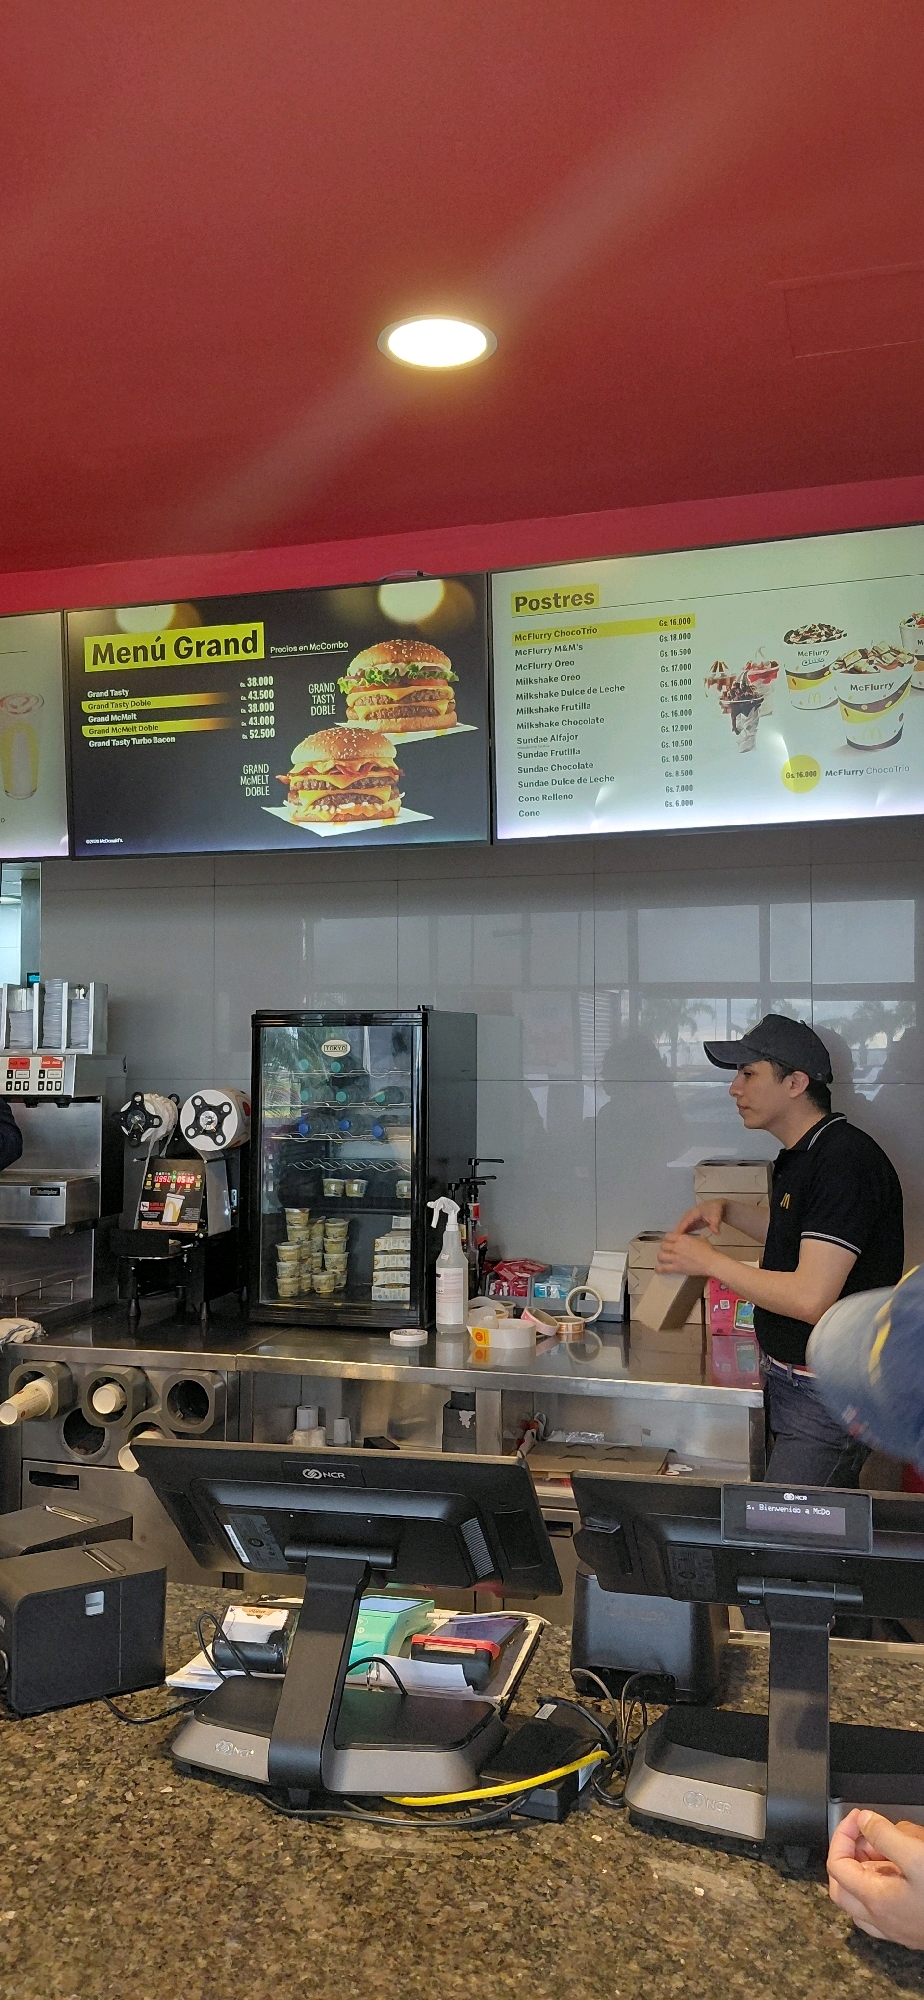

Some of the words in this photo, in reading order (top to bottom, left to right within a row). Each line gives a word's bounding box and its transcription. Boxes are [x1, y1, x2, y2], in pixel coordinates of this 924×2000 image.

[515, 592, 595, 612] Postres
[514, 632, 552, 642] McFlurry
[554, 626, 598, 638] ChocoTrio
[670, 617, 691, 626] 16.000
[92, 636, 166, 666] Menú
[174, 629, 258, 659] Grand
[270, 645, 297, 654] Precios
[309, 641, 348, 651] McCombo
[515, 647, 552, 657] McFlurry
[554, 643, 583, 652] M&M's
[670, 632, 691, 641] 18.000
[797, 649, 830, 657] McFlurry
[515, 661, 552, 671] McFlurry
[554, 659, 575, 668] Oreo
[660, 650, 668, 658] Gs.
[670, 648, 692, 657] 16.500
[515, 675, 559, 686] Milkshake
[560, 674, 581, 682] Oreo
[660, 665, 670, 673] Gs.
[671, 663, 692, 672] 17.000
[88, 690, 108, 698] Grand
[110, 688, 130, 698] Tasty
[247, 676, 274, 687] 38.000
[308, 682, 335, 694] GRAND
[516, 690, 559, 701] Milkshake
[561, 687, 585, 697] Dulce
[587, 686, 598, 694] de
[600, 684, 625, 694] Leche
[670, 678, 692, 687] 16.000
[850, 681, 894, 692] McFlurry
[88, 701, 109, 710] Grand
[110, 701, 130, 709] Tasty
[131, 700, 152, 708] Doble
[248, 689, 274, 700] 43.500
[312, 694, 336, 705] TASTY
[516, 705, 559, 715] Milkshake
[561, 702, 591, 712] Frutilla
[671, 694, 692, 702] 16.000
[88, 715, 109, 723] Grand
[111, 713, 137, 722] McMelt
[248, 702, 274, 713] 38.000
[311, 705, 336, 716] DOBLE
[516, 720, 560, 730] Milkshake
[561, 716, 605, 726] Chocolate
[661, 711, 670, 719] Gs.
[671, 709, 692, 718] 16.000
[89, 726, 110, 735] Grand
[111, 726, 137, 734] McMelt
[139, 724, 158, 732] Doble
[248, 716, 275, 726] 43.000
[516, 736, 548, 745] Sundae
[550, 733, 578, 744] Alfajor
[672, 724, 692, 732] 12.000
[89, 740, 110, 748] Grand
[111, 739, 130, 748] Tasty
[131, 737, 152, 745] Turbo
[153, 736, 176, 744] Bacon
[249, 728, 275, 739] 52.500
[517, 751, 548, 759] Sundae
[550, 748, 581, 757] Frutilla
[672, 739, 693, 748] 10.500
[243, 763, 269, 774] GRAND
[517, 765, 549, 774] Sundae
[551, 762, 594, 772] Chocolate
[672, 754, 693, 763] 10.500
[825, 768, 864, 777] McFlurry
[866, 765, 910, 774] ChocoTrio
[240, 775, 269, 785] McMELT
[518, 780, 549, 789] Sundae
[551, 778, 575, 786] Dulce
[589, 775, 615, 784] Leche
[675, 769, 693, 777] 8.500
[245, 786, 270, 797] DOBLE
[542, 793, 574, 801] Relleno
[676, 784, 693, 792] 7.000
[664, 800, 674, 808] Gs.
[675, 799, 694, 807] 6.000
[322, 1471, 346, 1479] NCR
[759, 1504, 801, 1514] Bienvenido
[706, 1798, 732, 1814] NCR
